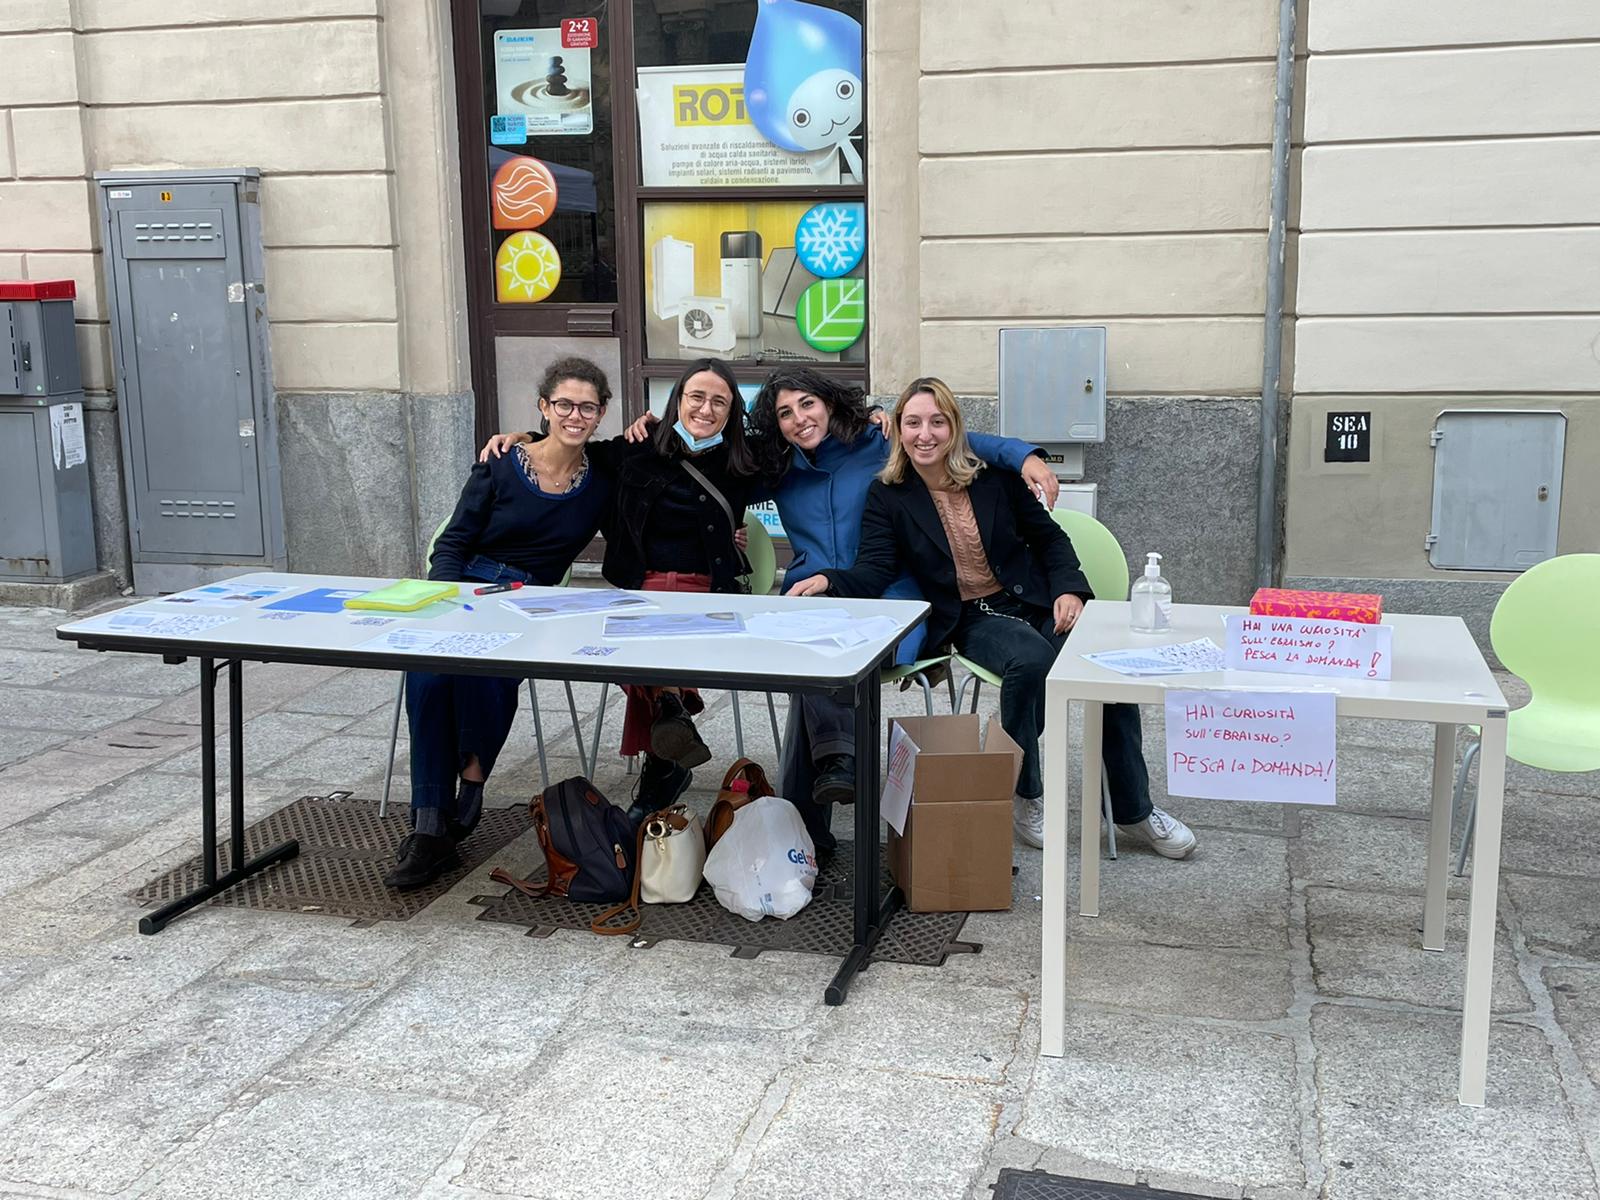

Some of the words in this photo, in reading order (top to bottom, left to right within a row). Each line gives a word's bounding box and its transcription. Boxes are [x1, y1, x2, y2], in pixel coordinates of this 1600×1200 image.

[569, 20, 589, 32] 2+2
[1332, 415, 1367, 432] SEA
[1337, 434, 1358, 449] 10
[1243, 620, 1261, 631] HAI
[1271, 622, 1293, 632] UNA
[1245, 648, 1277, 661] PESCA
[1286, 652, 1300, 662] LA
[1186, 703, 1214, 722] HAI
[1173, 752, 1225, 774] PESCA
